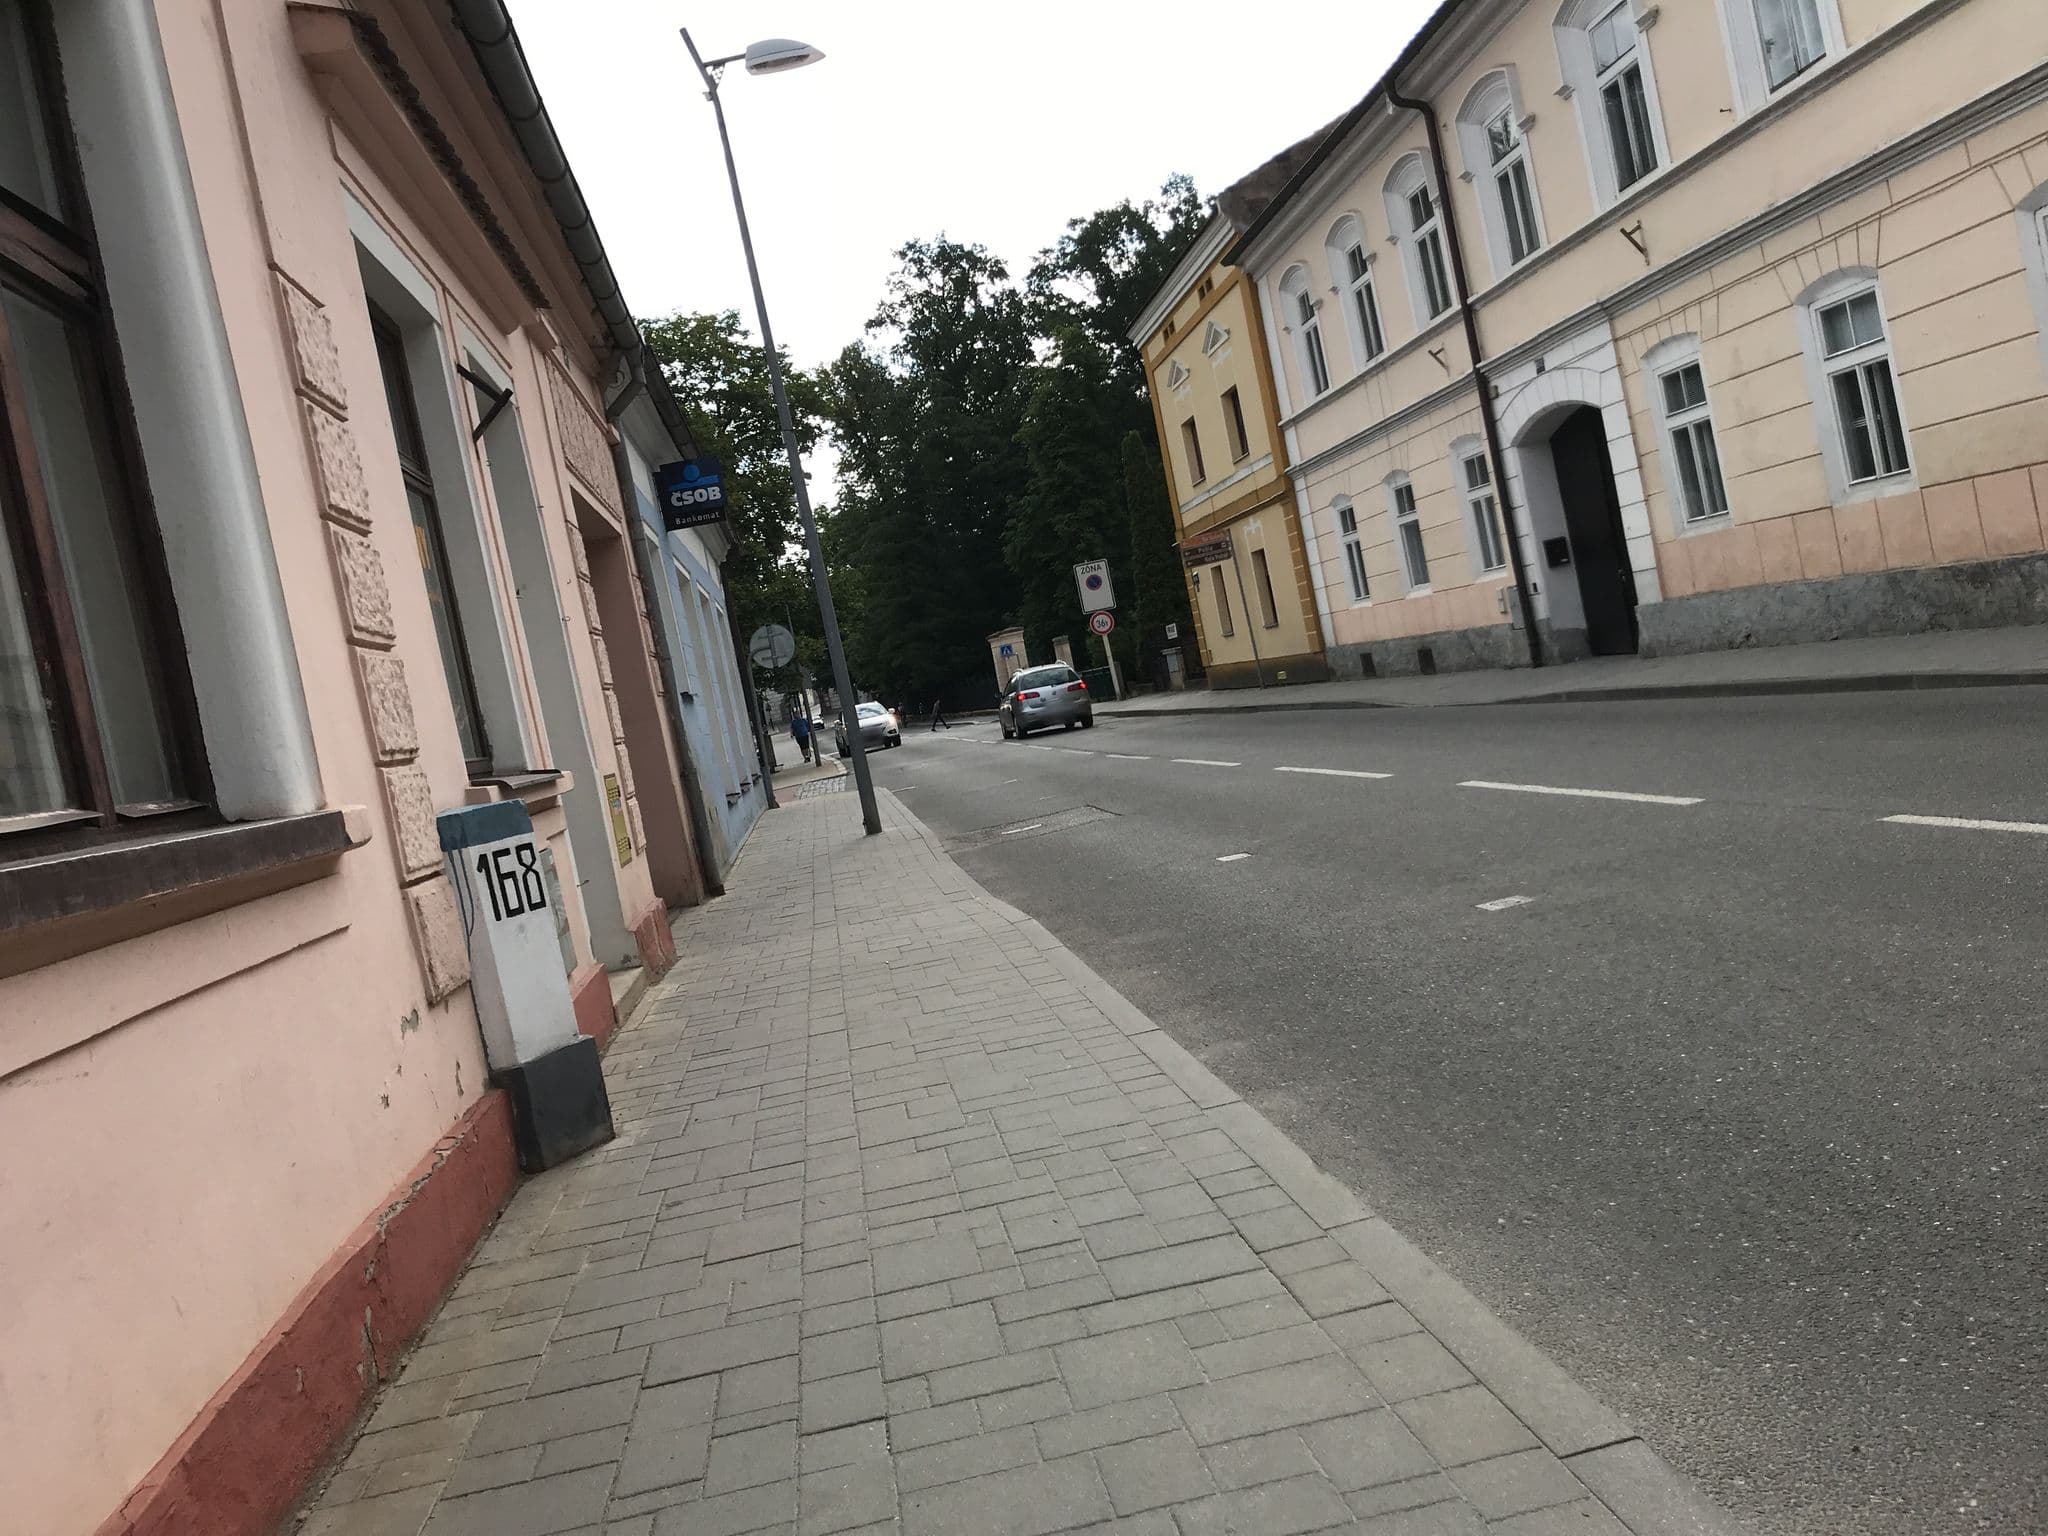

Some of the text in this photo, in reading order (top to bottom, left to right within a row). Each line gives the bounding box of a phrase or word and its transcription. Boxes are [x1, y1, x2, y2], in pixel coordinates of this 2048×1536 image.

[671, 487, 721, 506] ČSOB
[675, 512, 720, 525] Bankomat
[476, 842, 546, 921] 168
